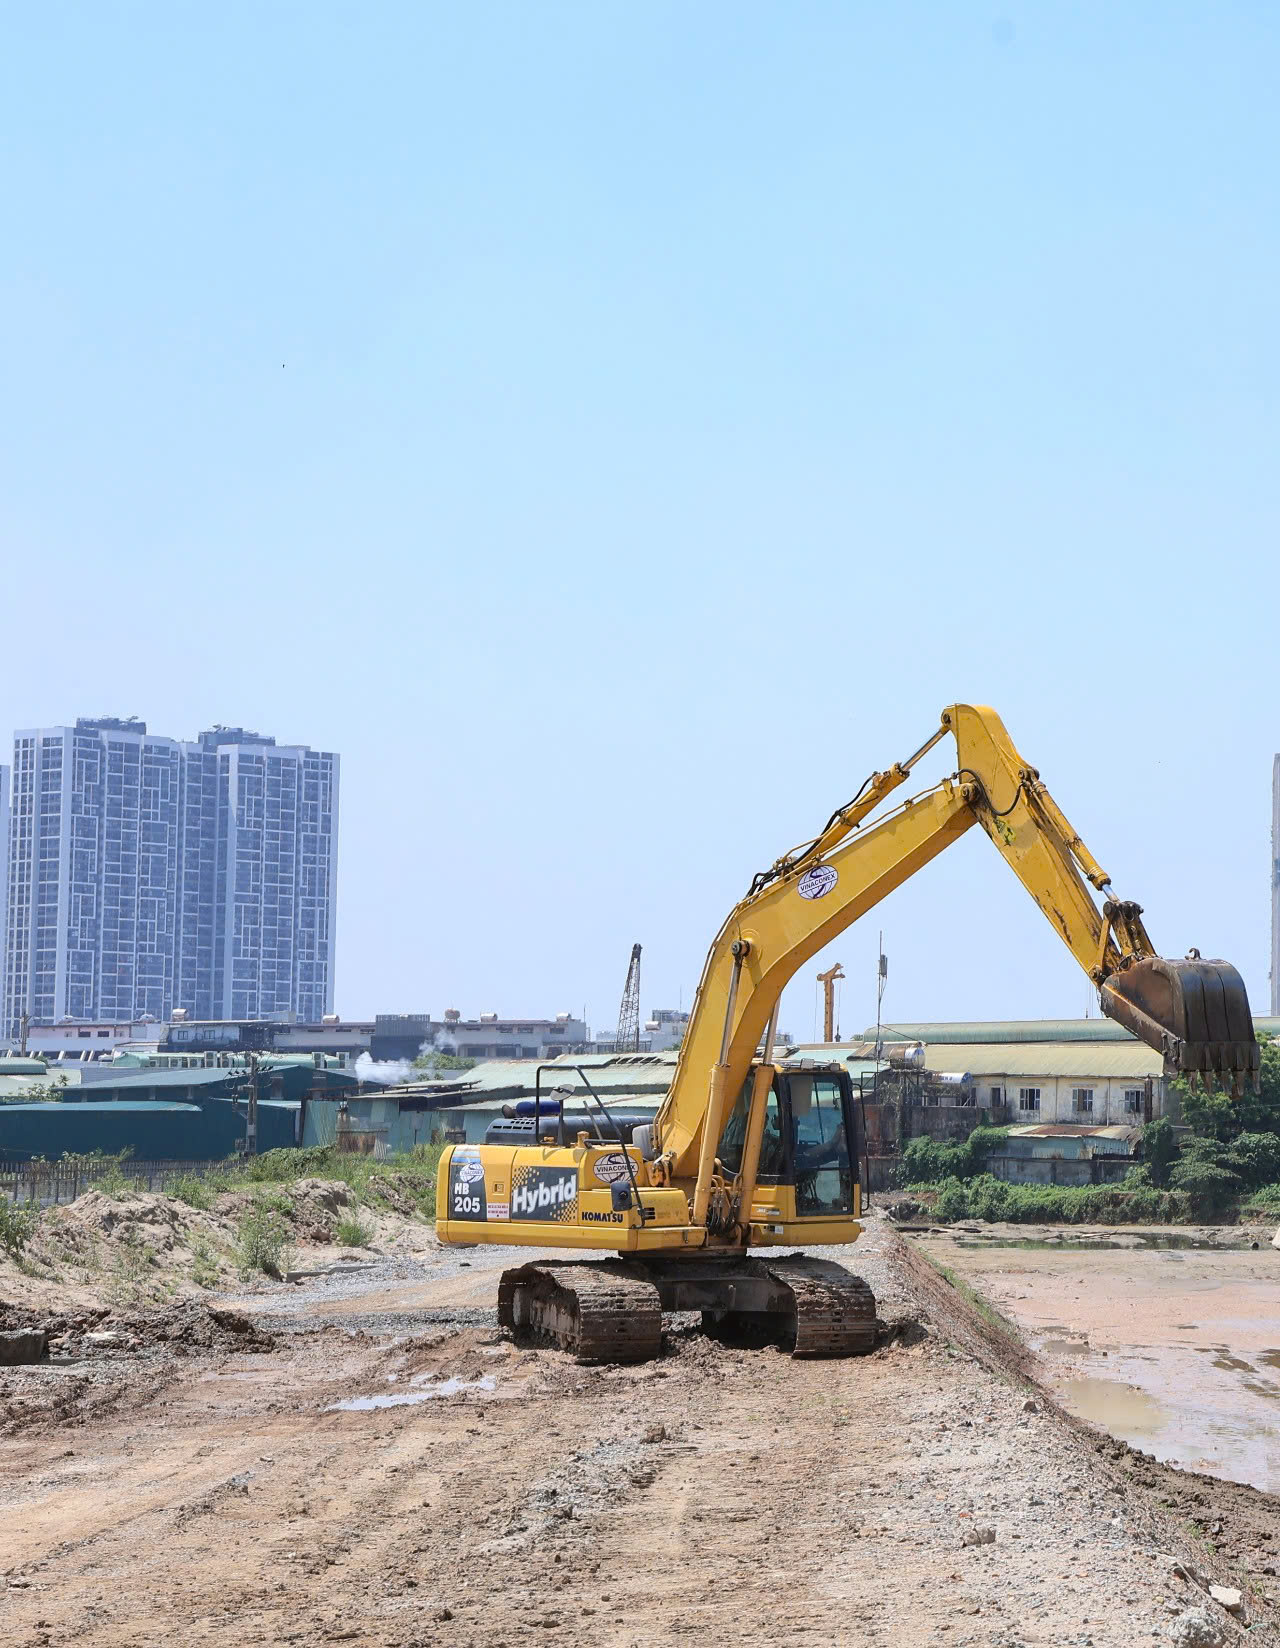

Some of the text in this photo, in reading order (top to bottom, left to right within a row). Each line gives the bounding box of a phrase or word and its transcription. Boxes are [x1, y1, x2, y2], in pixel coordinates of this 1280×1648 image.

[800, 873, 836, 891] VINACONEX
[454, 1182, 470, 1195] HB
[512, 1174, 577, 1214] Hybrid
[454, 1196, 481, 1213] 205
[581, 1210, 624, 1223] KOMATSU
